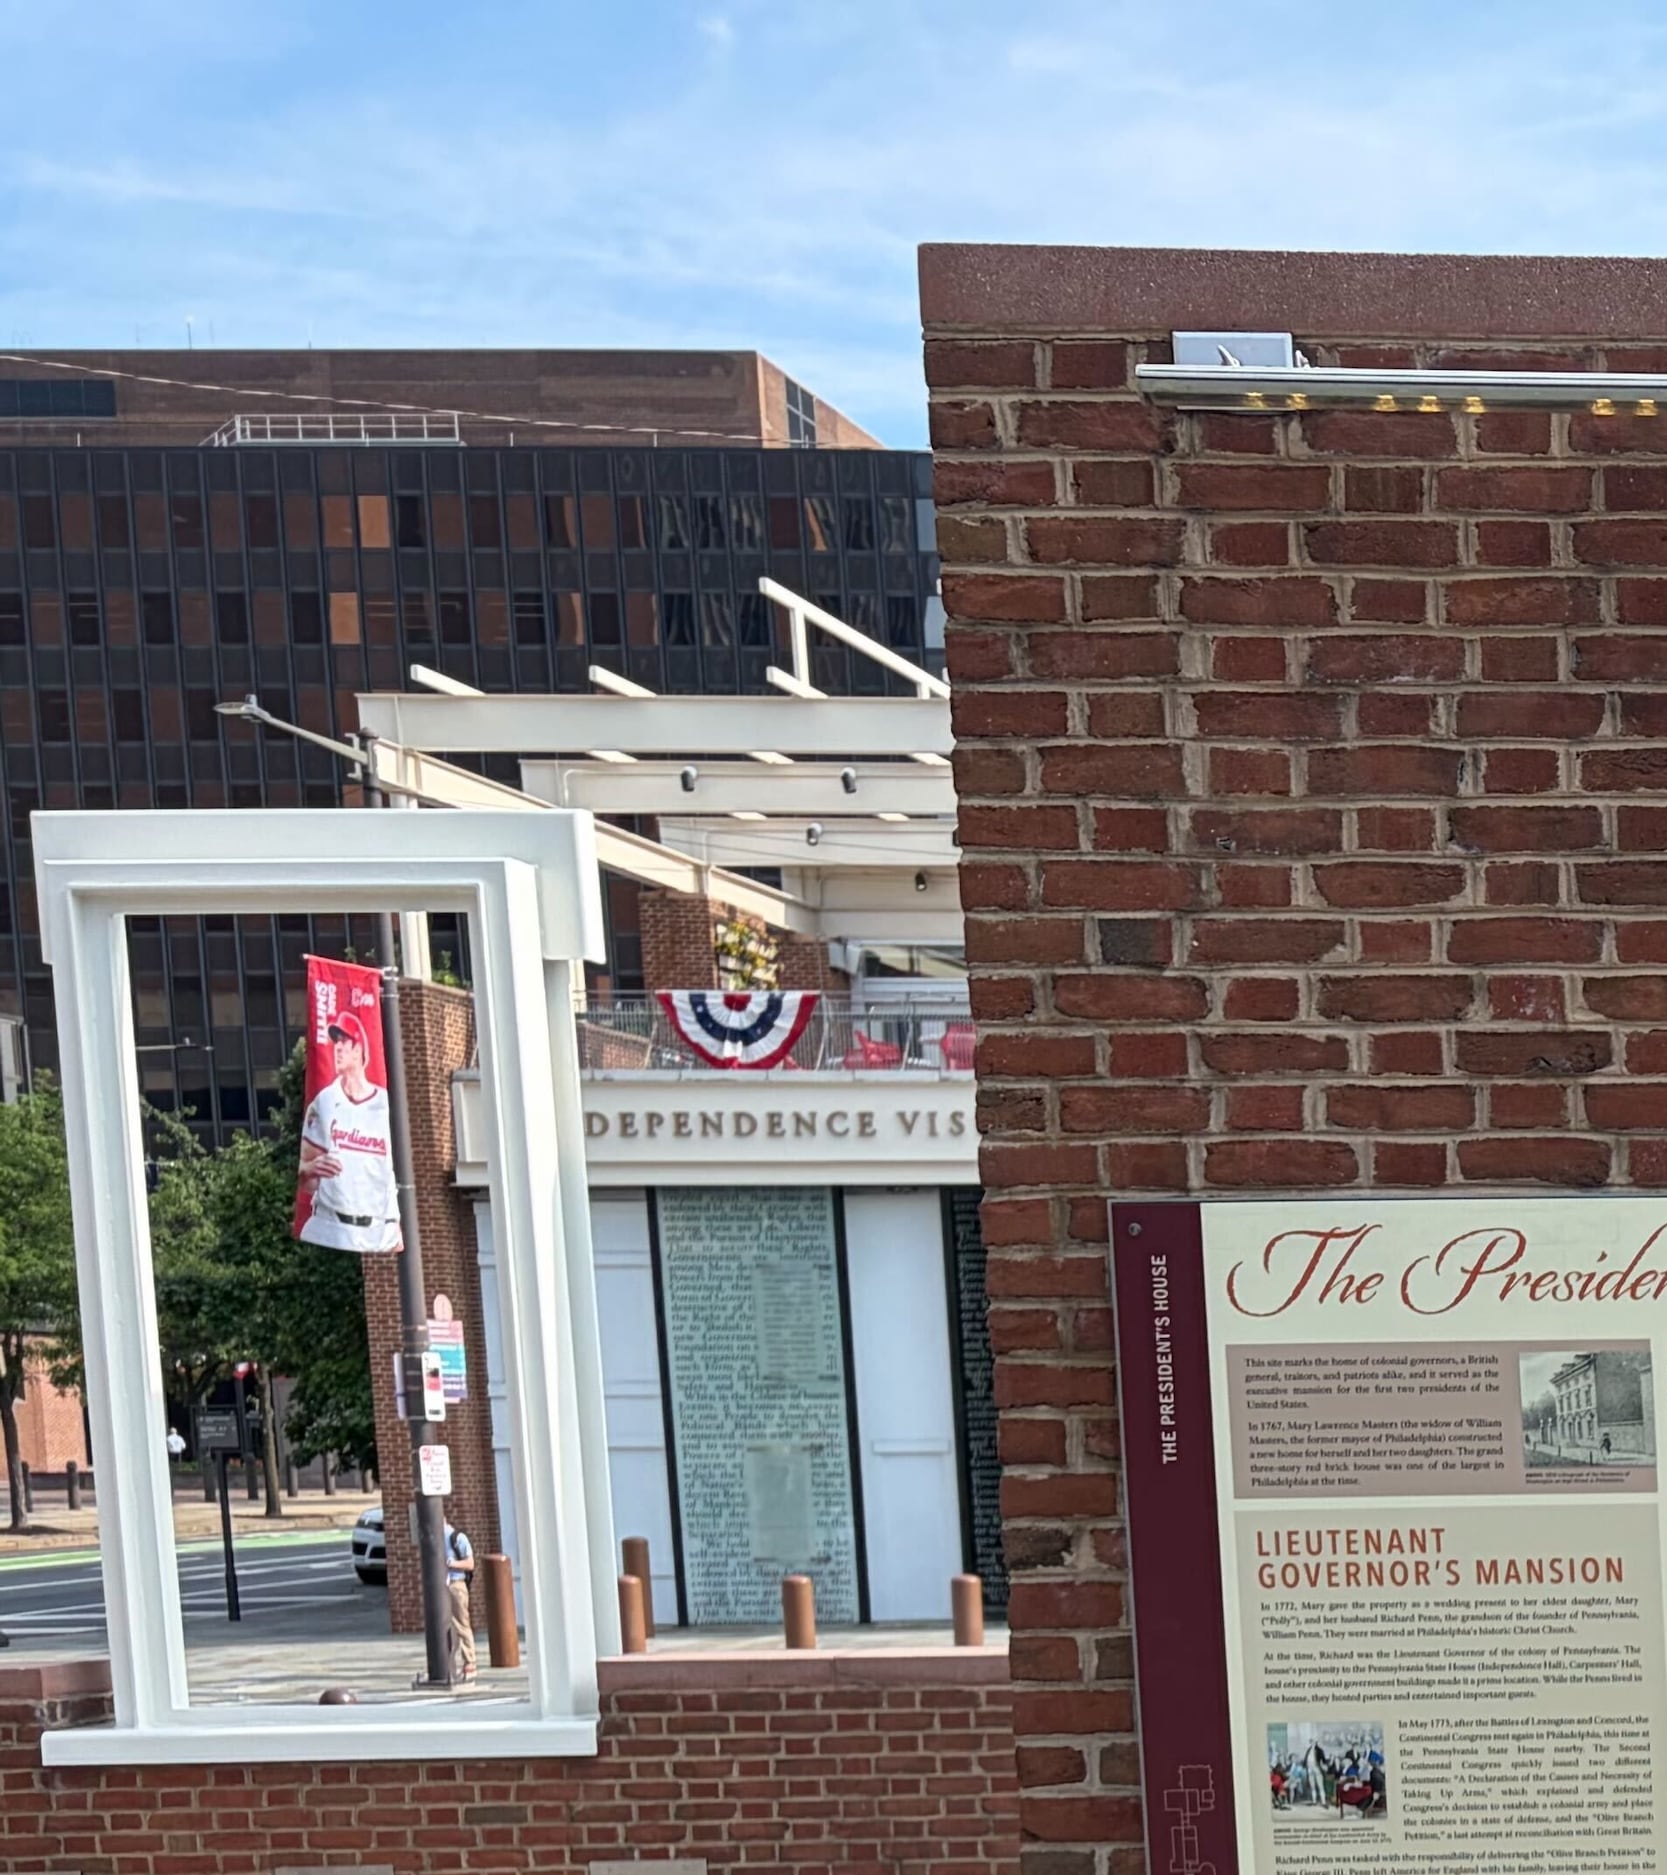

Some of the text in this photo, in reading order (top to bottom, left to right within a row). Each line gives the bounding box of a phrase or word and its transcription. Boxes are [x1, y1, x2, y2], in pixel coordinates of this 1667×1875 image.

[585, 1111, 966, 1138] DEPENDENCE VIS
[1226, 1222, 1384, 1316] The
[1151, 1255, 1177, 1464] THE PRESIDENT'S HOUSE
[1257, 1528, 1442, 1556] LIEUTENANT
[1259, 1557, 1624, 1588] GOVERNOR'S MANSION
